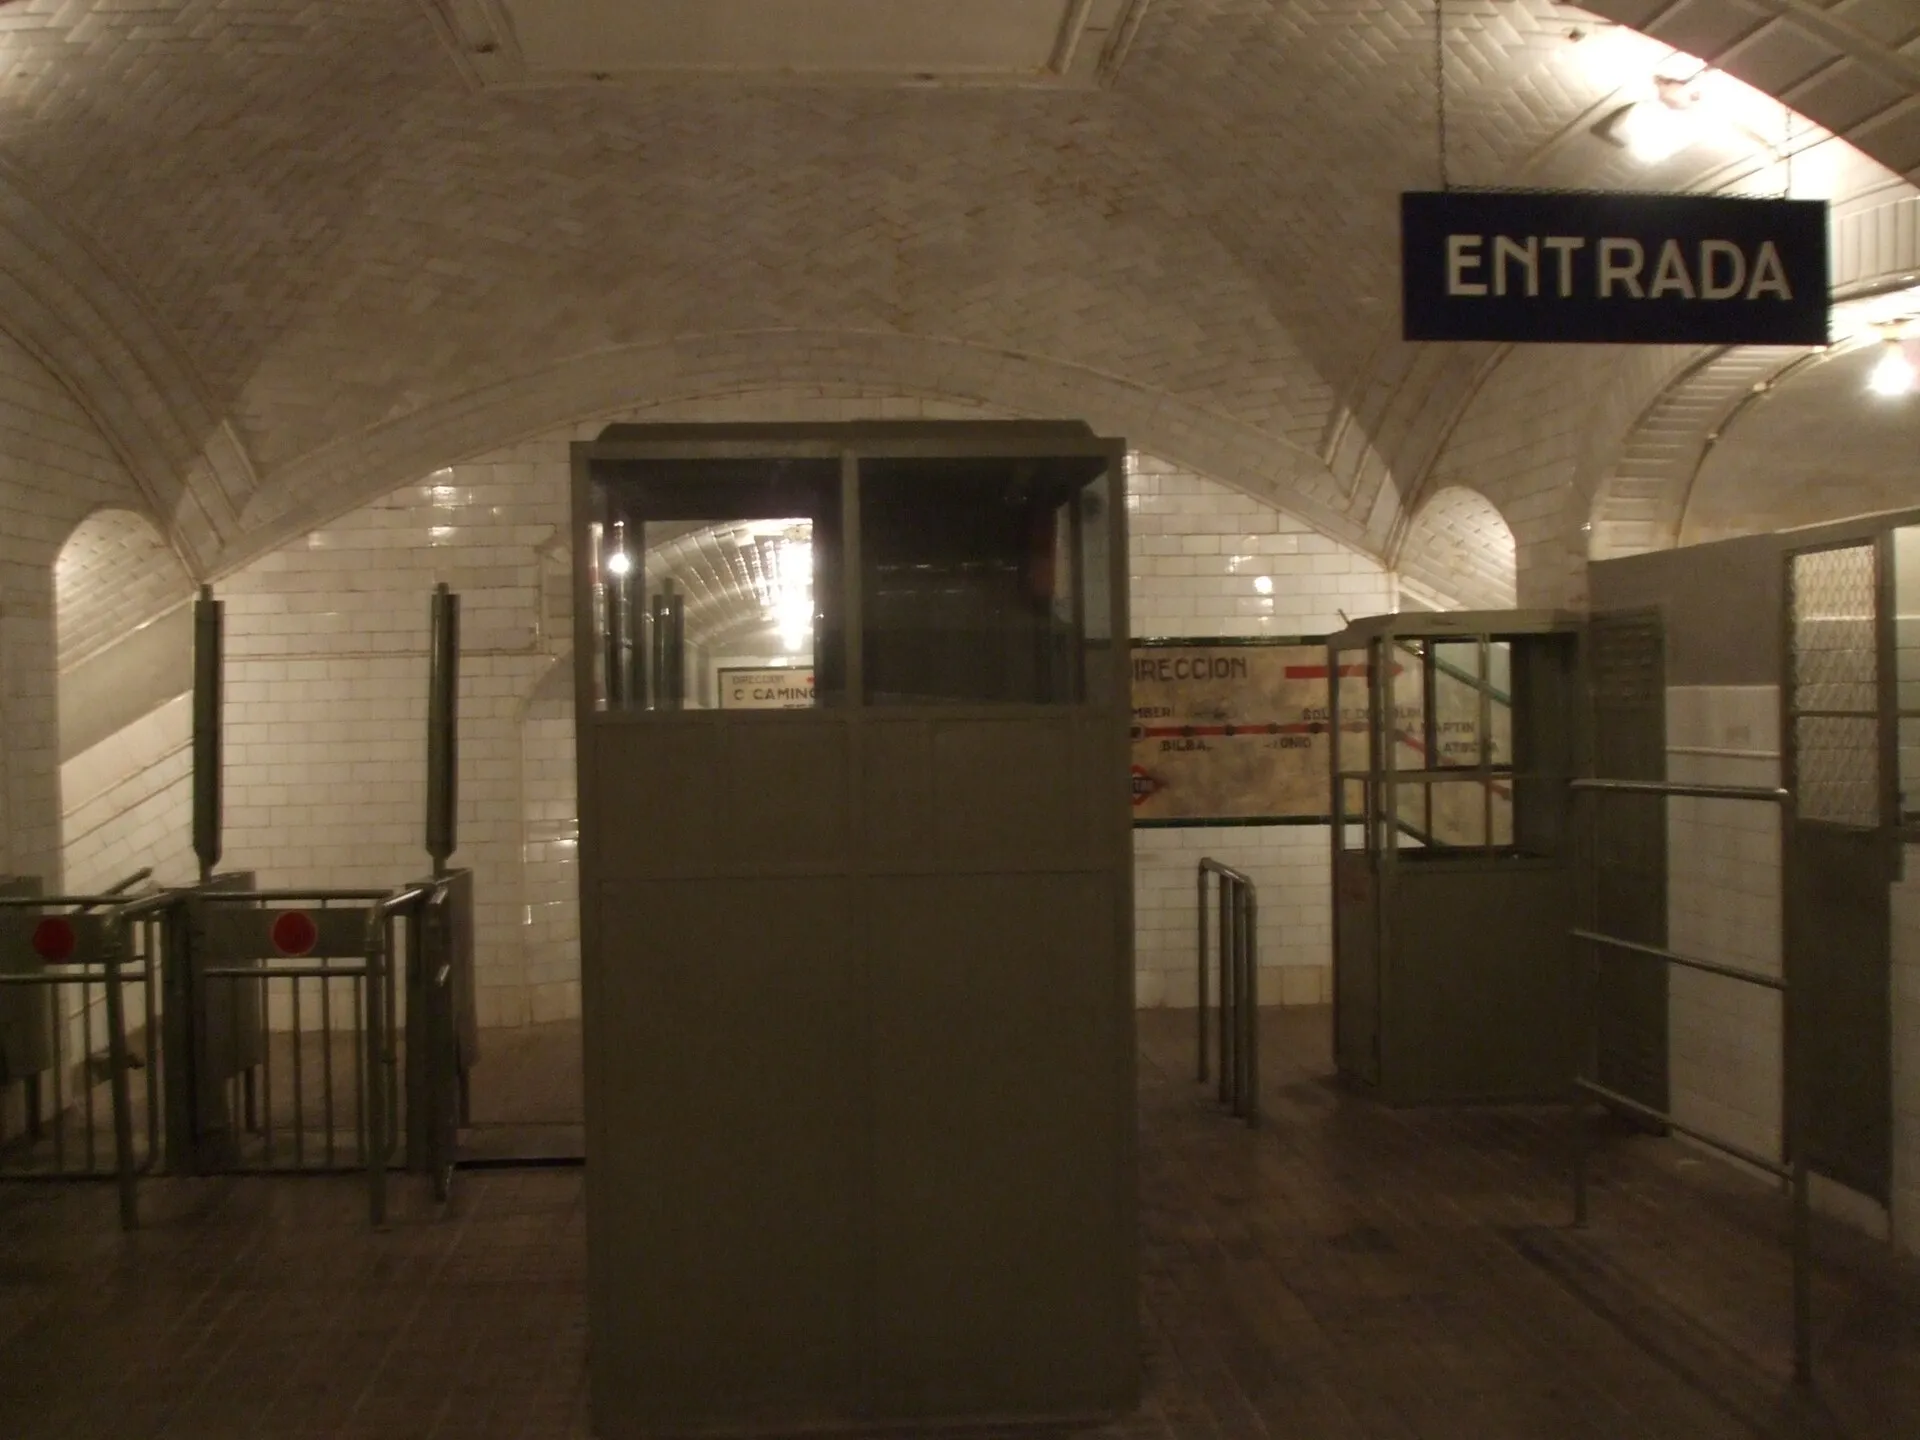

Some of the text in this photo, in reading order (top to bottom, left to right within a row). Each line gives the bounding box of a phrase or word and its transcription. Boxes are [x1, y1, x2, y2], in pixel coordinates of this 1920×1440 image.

[1446, 233, 1793, 301] ENTRADA
[1133, 656, 1248, 683] IRECCION
[1131, 706, 1176, 718] MBERI
[1159, 739, 1213, 752] BILBA
